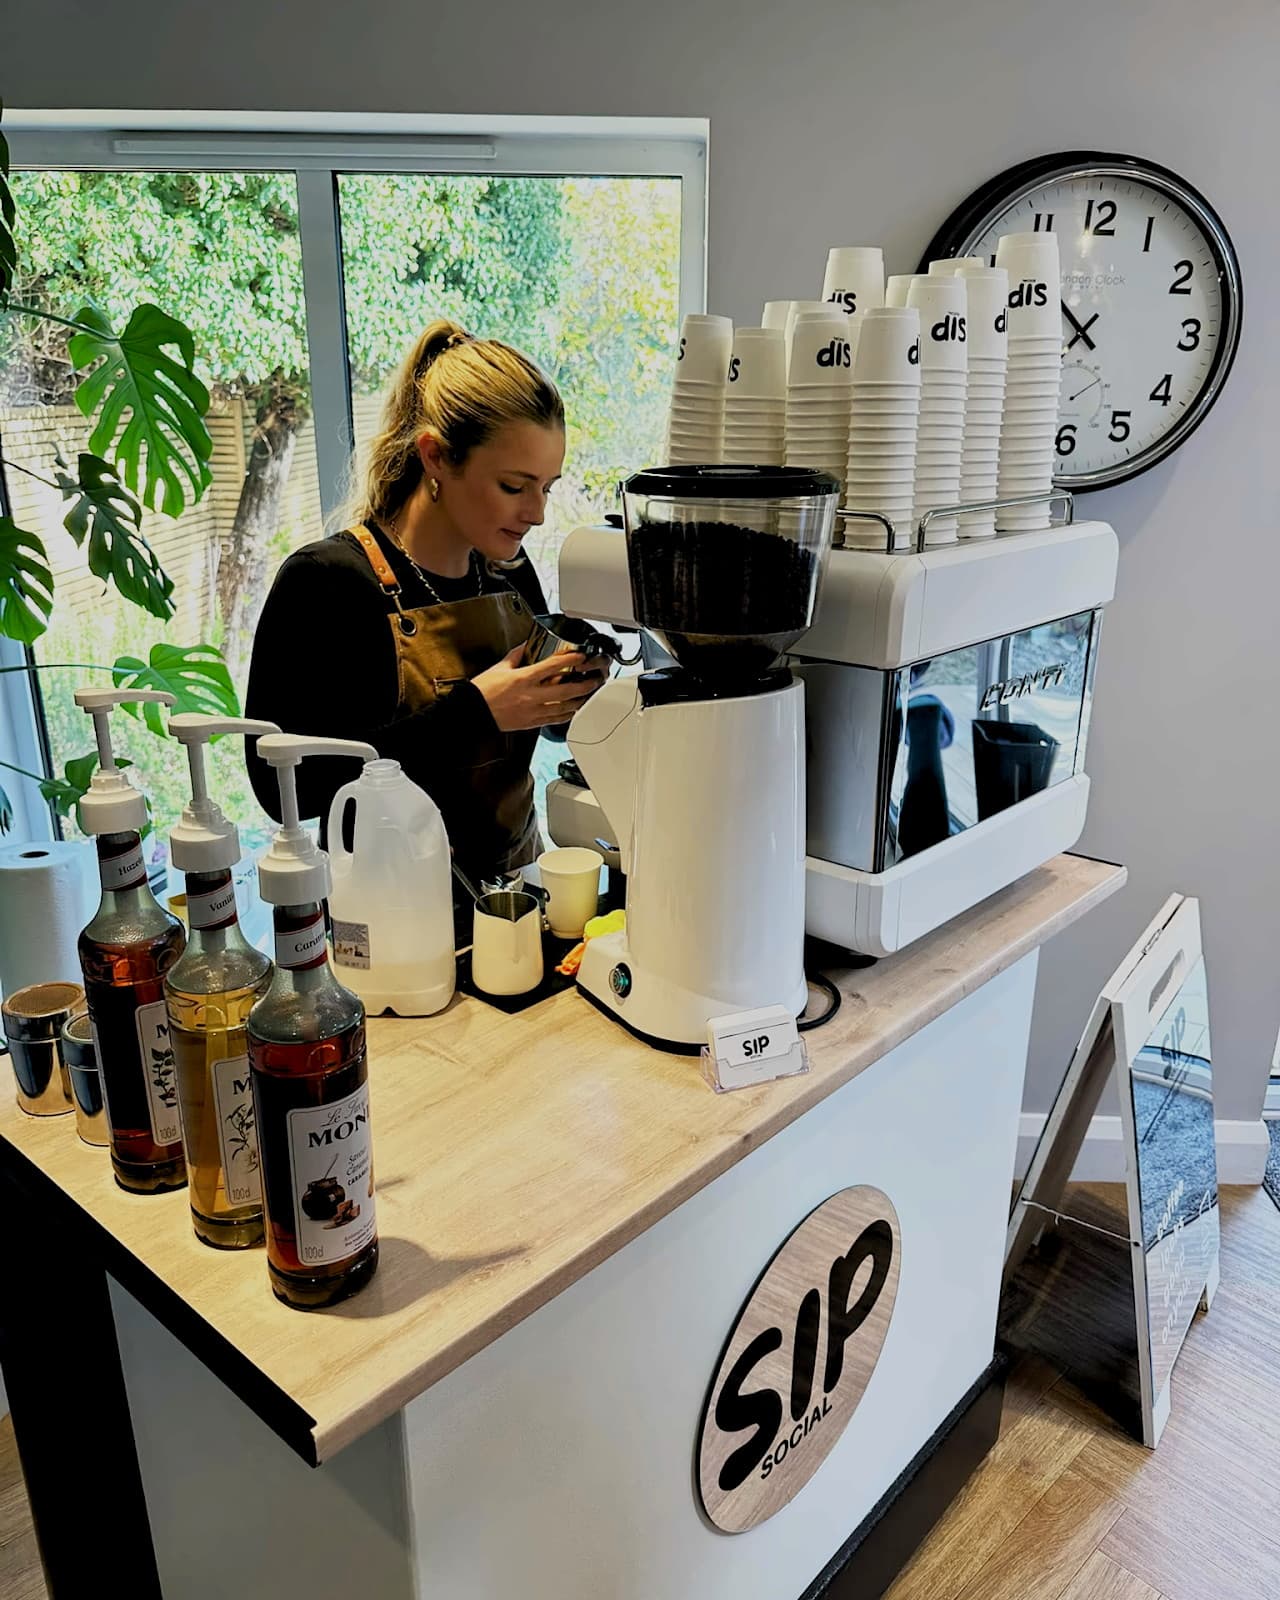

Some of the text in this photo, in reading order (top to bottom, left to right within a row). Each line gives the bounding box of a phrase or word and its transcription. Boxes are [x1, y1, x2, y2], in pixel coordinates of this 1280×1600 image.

[1084, 200, 1118, 237] 12
[1143, 216, 1156, 252] 1
[1168, 260, 1194, 295] 2
[1177, 318, 1201, 352] 3
[1149, 374, 1173, 406] 4
[1055, 424, 1078, 456] 6
[1108, 410, 1131, 442] 5
[742, 1035, 770, 1057] SIP
[715, 1219, 893, 1491] SIP
[761, 1397, 832, 1480] SOCIAL
